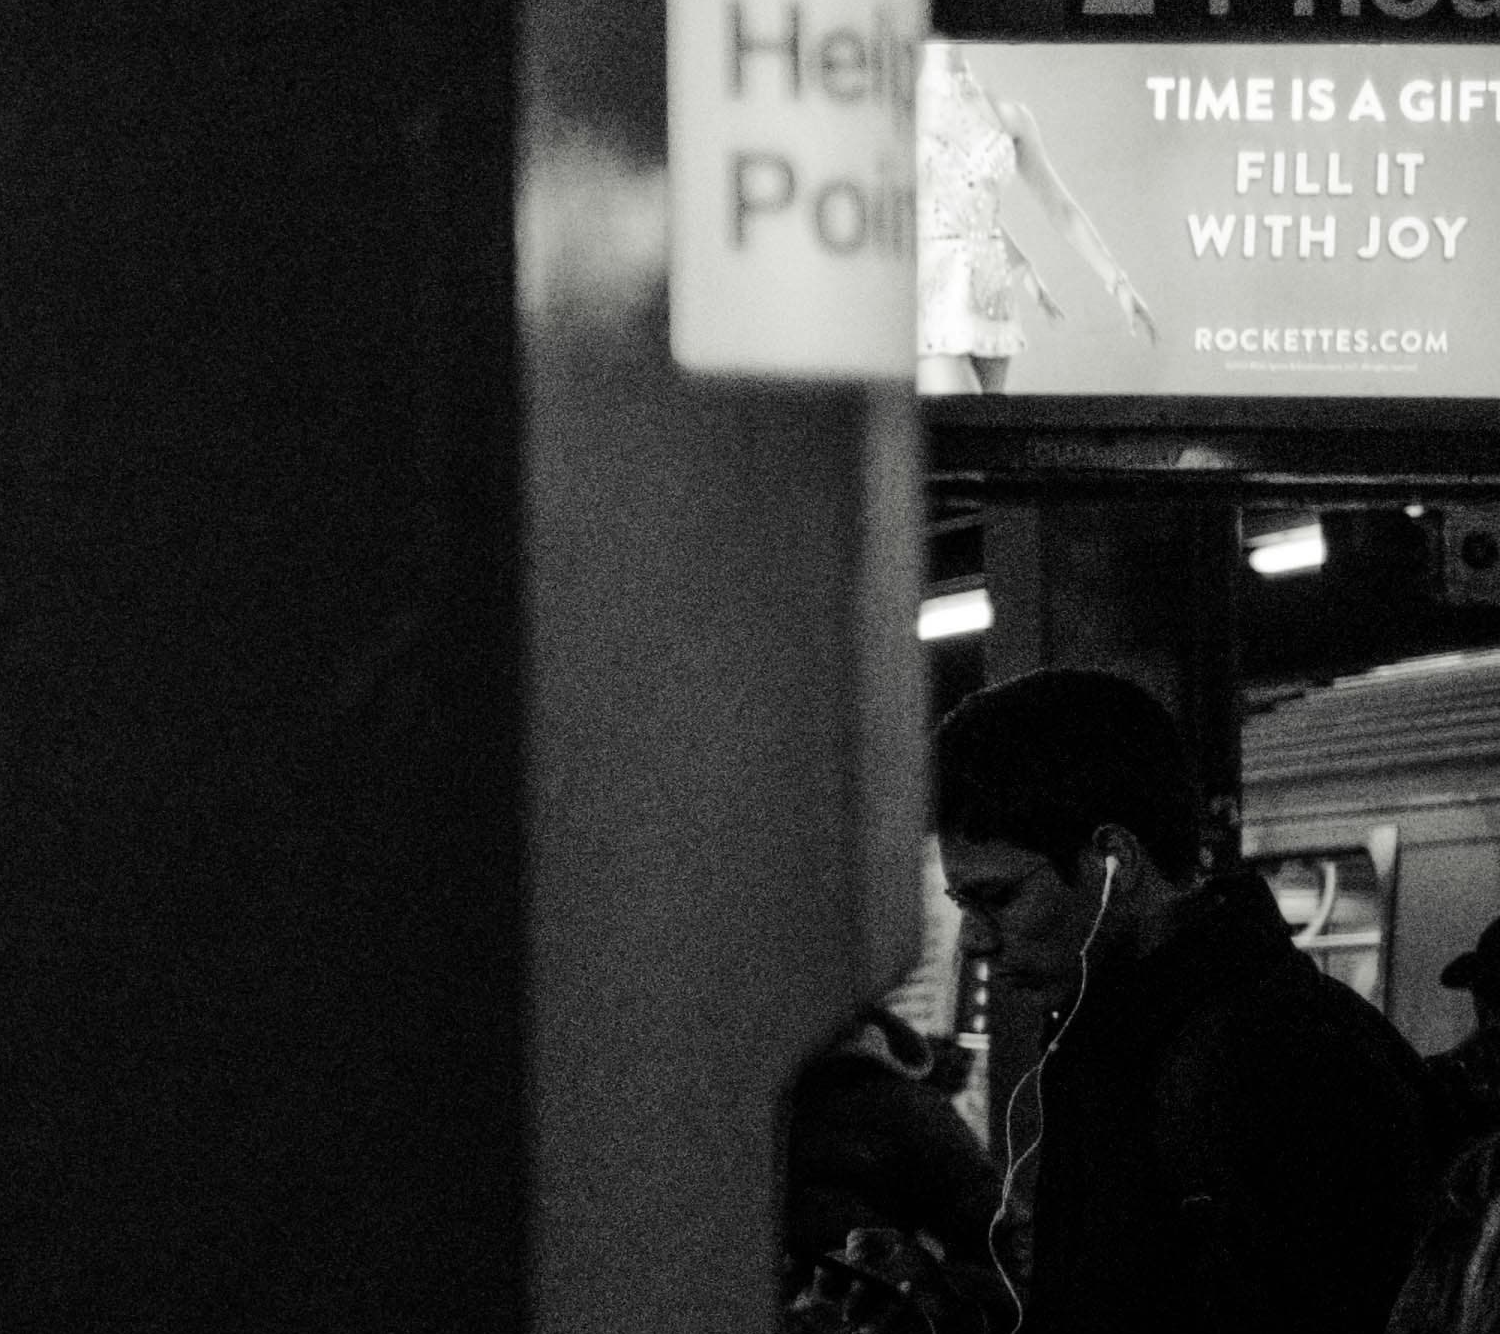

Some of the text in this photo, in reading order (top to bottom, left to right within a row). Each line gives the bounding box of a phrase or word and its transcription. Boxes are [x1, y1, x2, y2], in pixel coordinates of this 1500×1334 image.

[1146, 76, 1275, 121] TIME
[1291, 76, 1336, 122] IS
[1348, 78, 1387, 122] A
[1236, 151, 1424, 195] FILL IT
[1188, 215, 1467, 259] WITH JOY
[1194, 327, 1448, 353] ROCKETTES.COM
